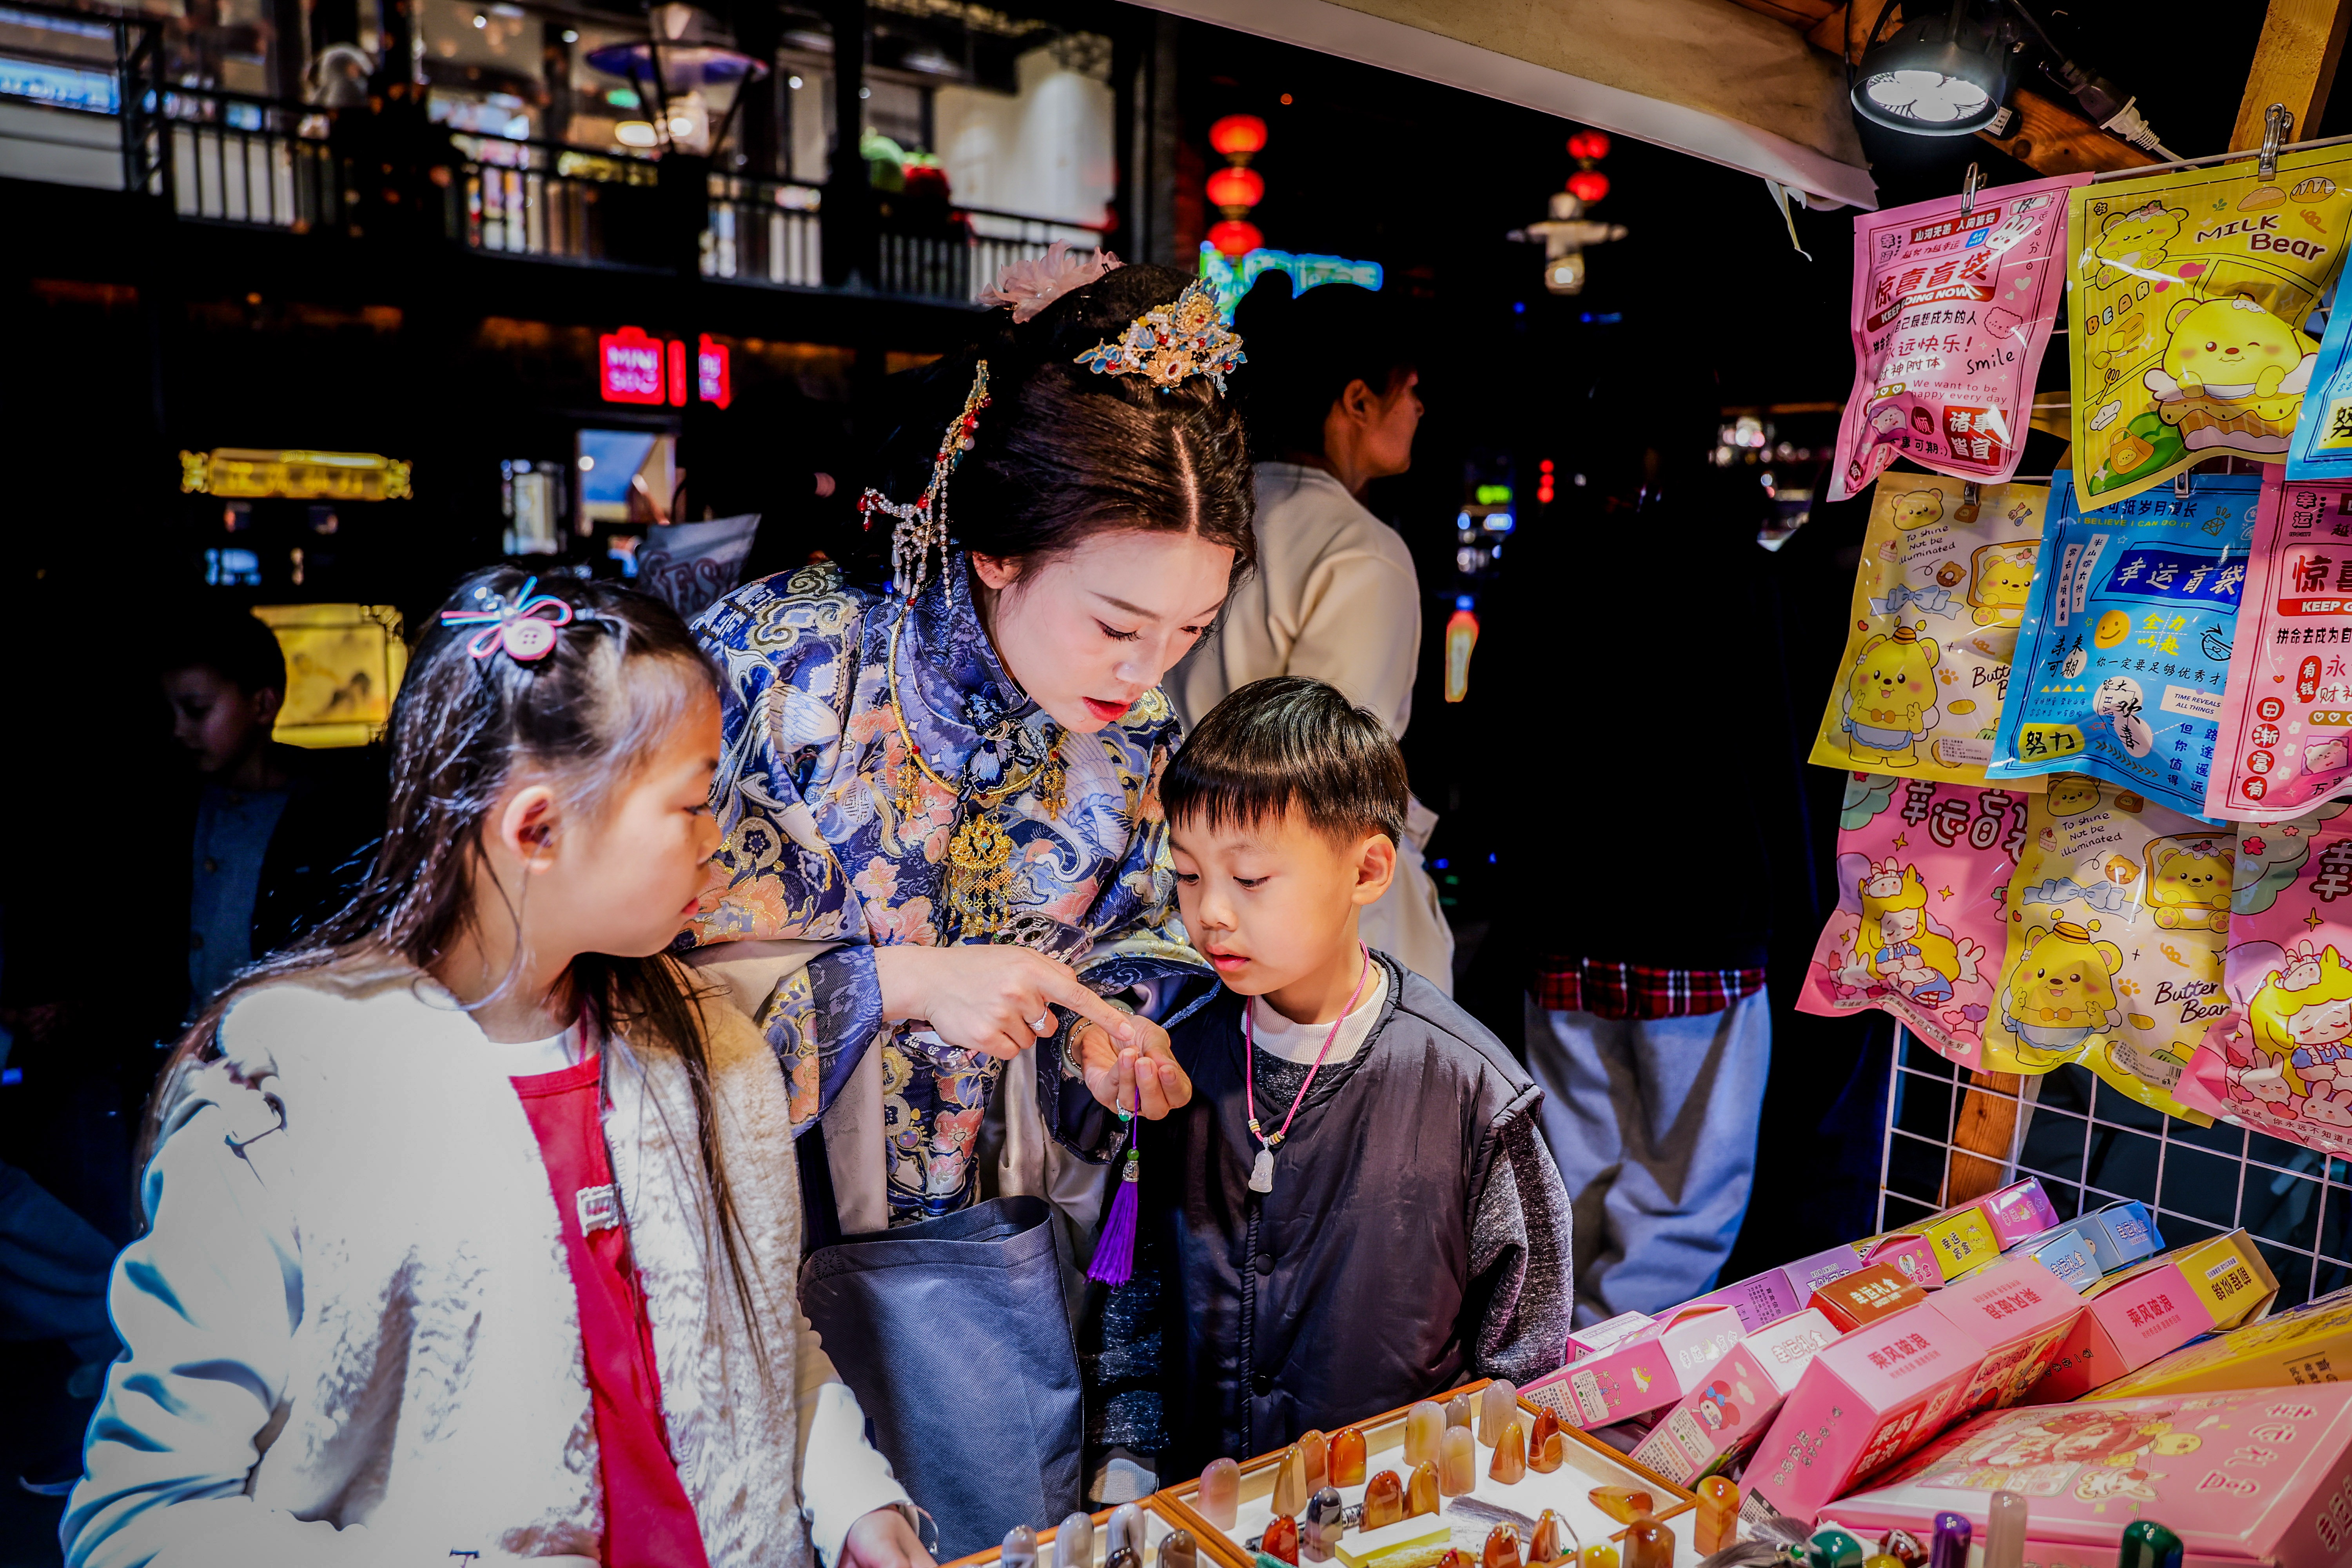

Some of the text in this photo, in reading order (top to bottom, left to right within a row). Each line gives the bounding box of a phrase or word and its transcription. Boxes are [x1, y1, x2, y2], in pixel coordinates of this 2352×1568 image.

[1956, 212, 1996, 232] 人间皆安
[2197, 214, 2280, 244] MILK
[2250, 232, 2327, 263] Bear
[1875, 250, 1993, 310] 惊喜盲袋
[1881, 304, 1901, 324] KEEP
[2085, 280, 2151, 336] BEAR
[1967, 348, 2015, 375] smile
[1911, 389, 2007, 405] happy every day
[1934, 381, 1962, 390] want
[1967, 382, 1978, 391] to
[1984, 384, 1998, 393] be
[1951, 437, 1992, 460] 皆宜
[2083, 517, 2127, 526] BELIEVE
[2292, 491, 2317, 529] 幸运
[1907, 526, 1949, 543] To shine
[1909, 541, 1927, 550] Not
[1899, 541, 1956, 565] illuminated
[2118, 557, 2245, 595] 幸运盲袋
[2301, 601, 2341, 613] KEEP
[2143, 612, 2186, 632] 全力
[2096, 656, 2229, 686] 你一定要足够优秀才
[2189, 705, 2214, 714] THINGS
[2191, 697, 2221, 708] REVEALS
[2025, 730, 2075, 757] 努力
[2167, 722, 2193, 786] 但你值得
[2062, 813, 2110, 831] To shine
[2069, 825, 2105, 841] Not be
[2060, 832, 2123, 857] illuminated
[2154, 980, 2218, 1005] Butter
[2180, 998, 2230, 1024] Bear
[2231, 1102, 2262, 1119] 不试试
[2115, 1217, 2149, 1240] 幸运礼盒
[2130, 1237, 2139, 1246] LUCKY
[1810, 1263, 1839, 1278] LUCKY BOX
[2051, 1250, 2086, 1279] 幸运礼盒
[2065, 1269, 2085, 1284] LUCKY BOX
[1849, 1278, 1901, 1305] 幸运礼盒
[2210, 1266, 2252, 1301] 前程似锦
[1766, 1287, 1781, 1316] 盲盒信息
[1982, 1287, 2043, 1320] 乘风破浪
[2126, 1294, 2175, 1328] 乘风破浪
[1771, 1330, 1829, 1364] 幸运礼盒
[1867, 1332, 1931, 1370] 乘风破浪
